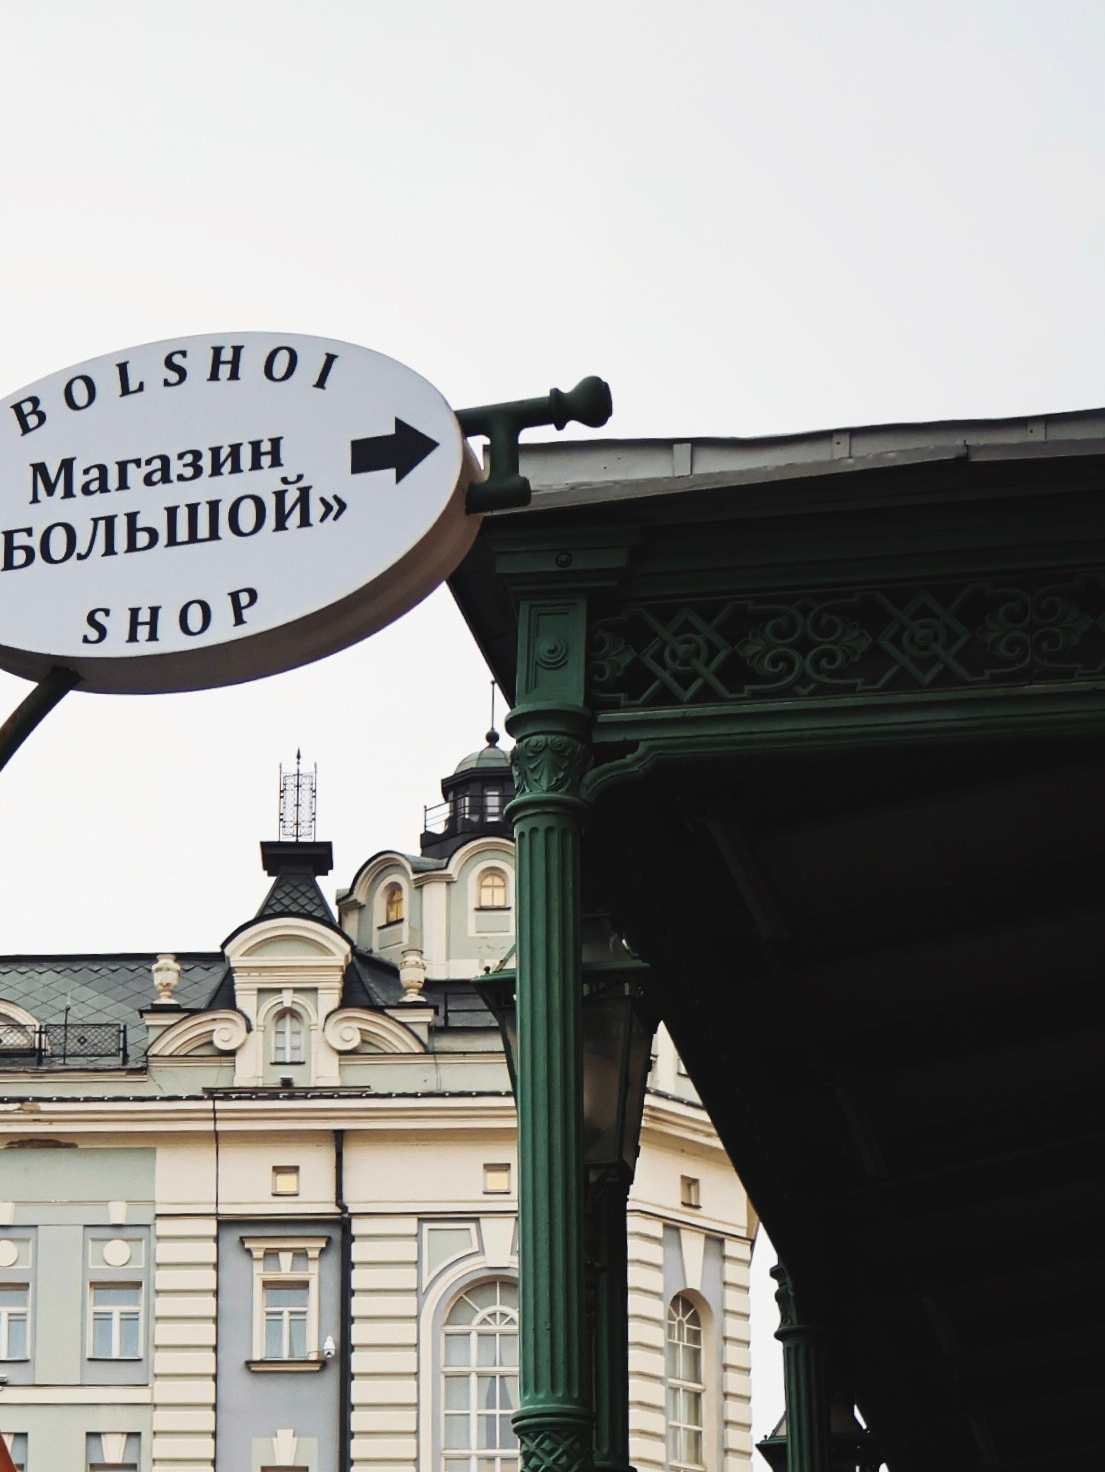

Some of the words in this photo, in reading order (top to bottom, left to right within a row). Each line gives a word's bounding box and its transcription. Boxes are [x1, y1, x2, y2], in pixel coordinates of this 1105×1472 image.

[9, 344, 339, 437] BOLSHOI
[28, 435, 284, 505] Магазин
[81, 587, 259, 645] SHOP
